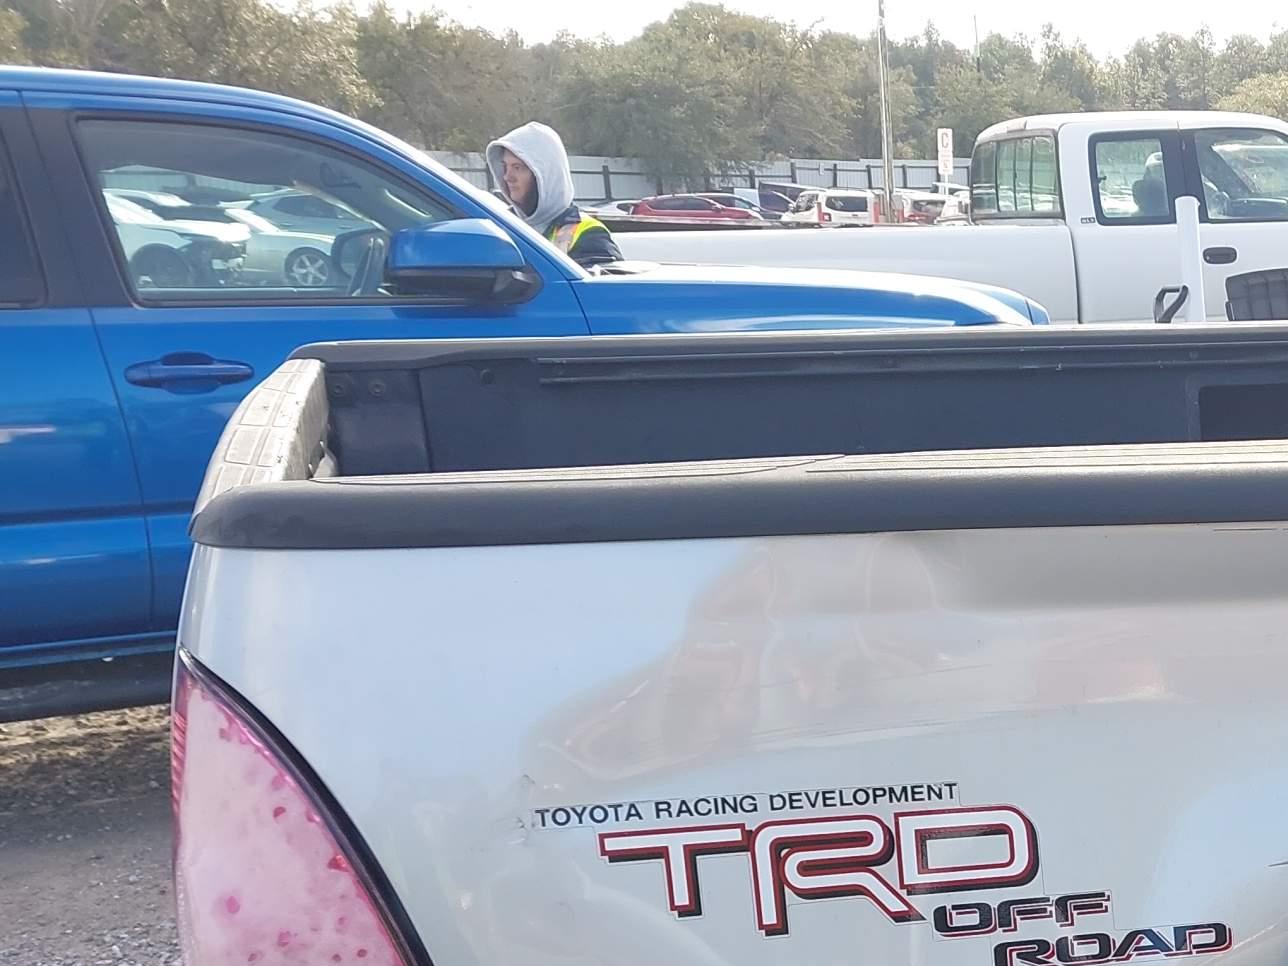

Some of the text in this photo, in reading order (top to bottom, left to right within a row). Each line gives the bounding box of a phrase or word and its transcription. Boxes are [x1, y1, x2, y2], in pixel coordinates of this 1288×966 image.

[535, 782, 958, 828] TOYOTA RACING DEVELOPMENT
[600, 804, 1040, 939] TRD
[932, 891, 1110, 936] OFF
